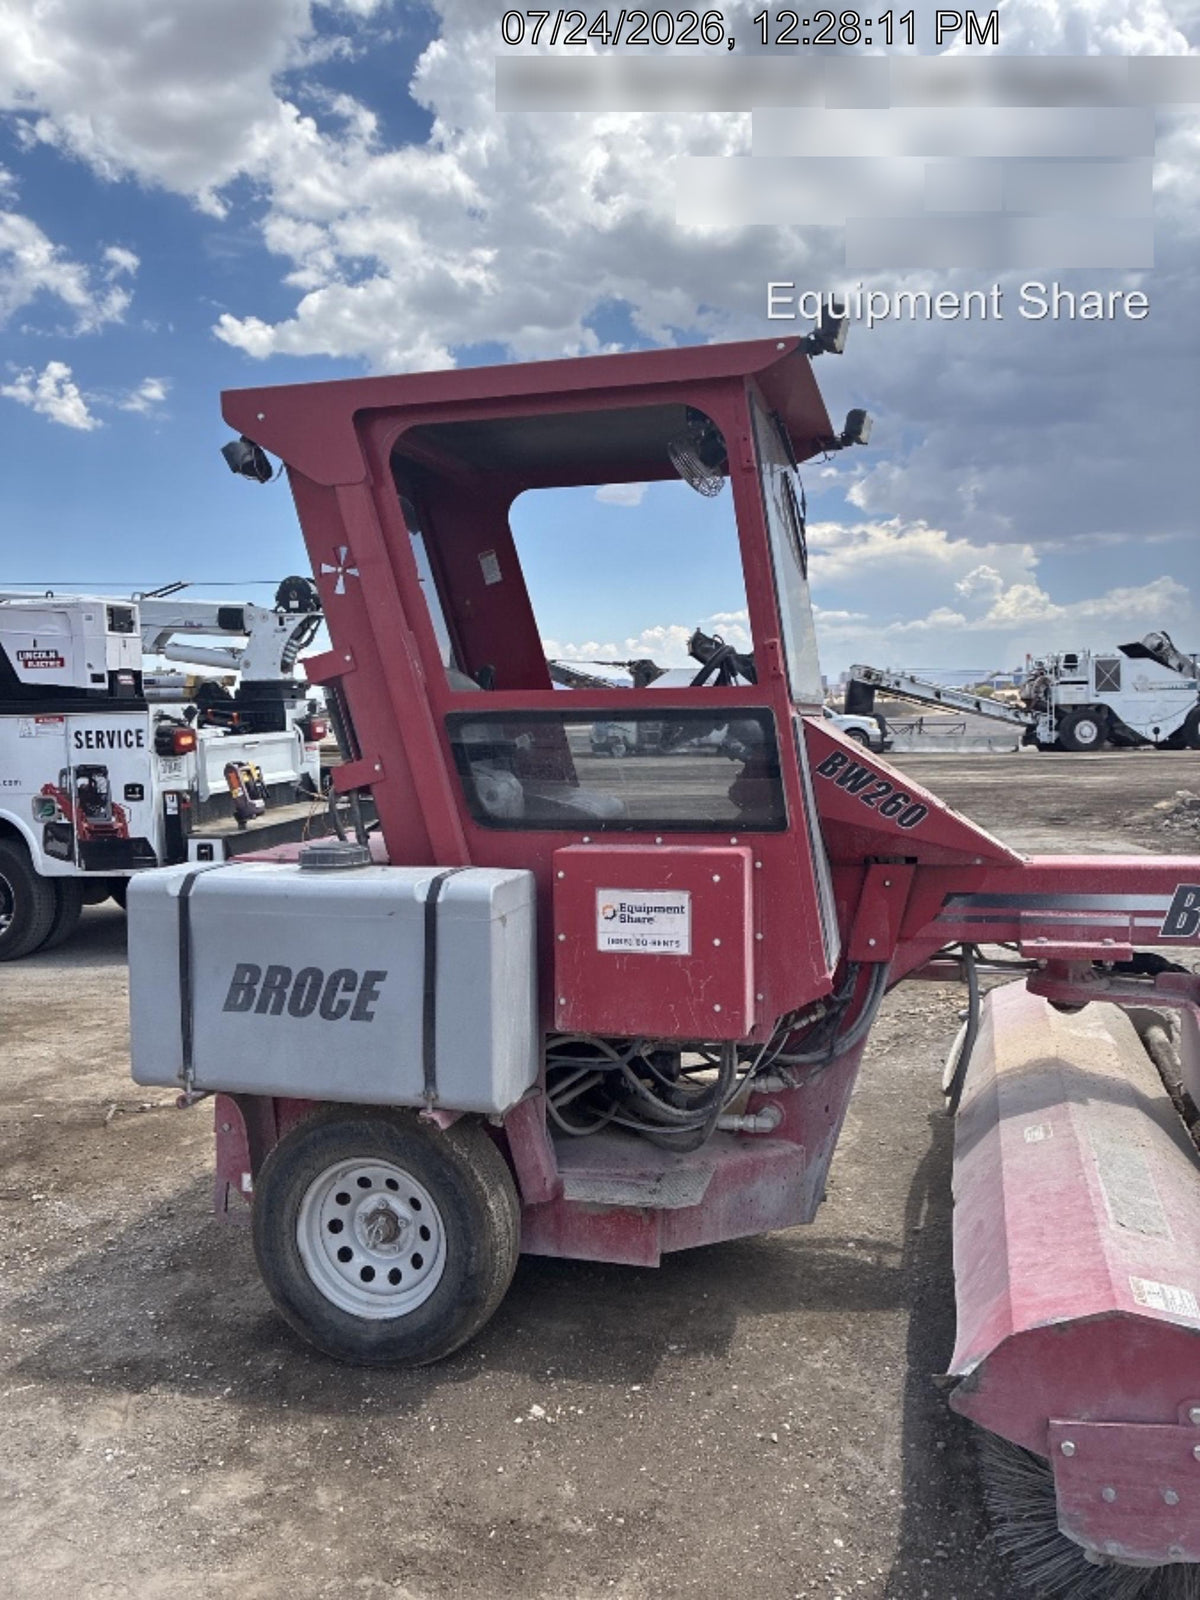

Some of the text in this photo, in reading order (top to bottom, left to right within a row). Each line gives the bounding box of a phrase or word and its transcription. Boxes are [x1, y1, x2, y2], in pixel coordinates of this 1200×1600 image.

[74, 729, 145, 749] SERVICE
[816, 750, 929, 829] BW260
[619, 903, 686, 915] Equipment
[619, 913, 655, 924] Share
[222, 963, 388, 1022] BROCE
